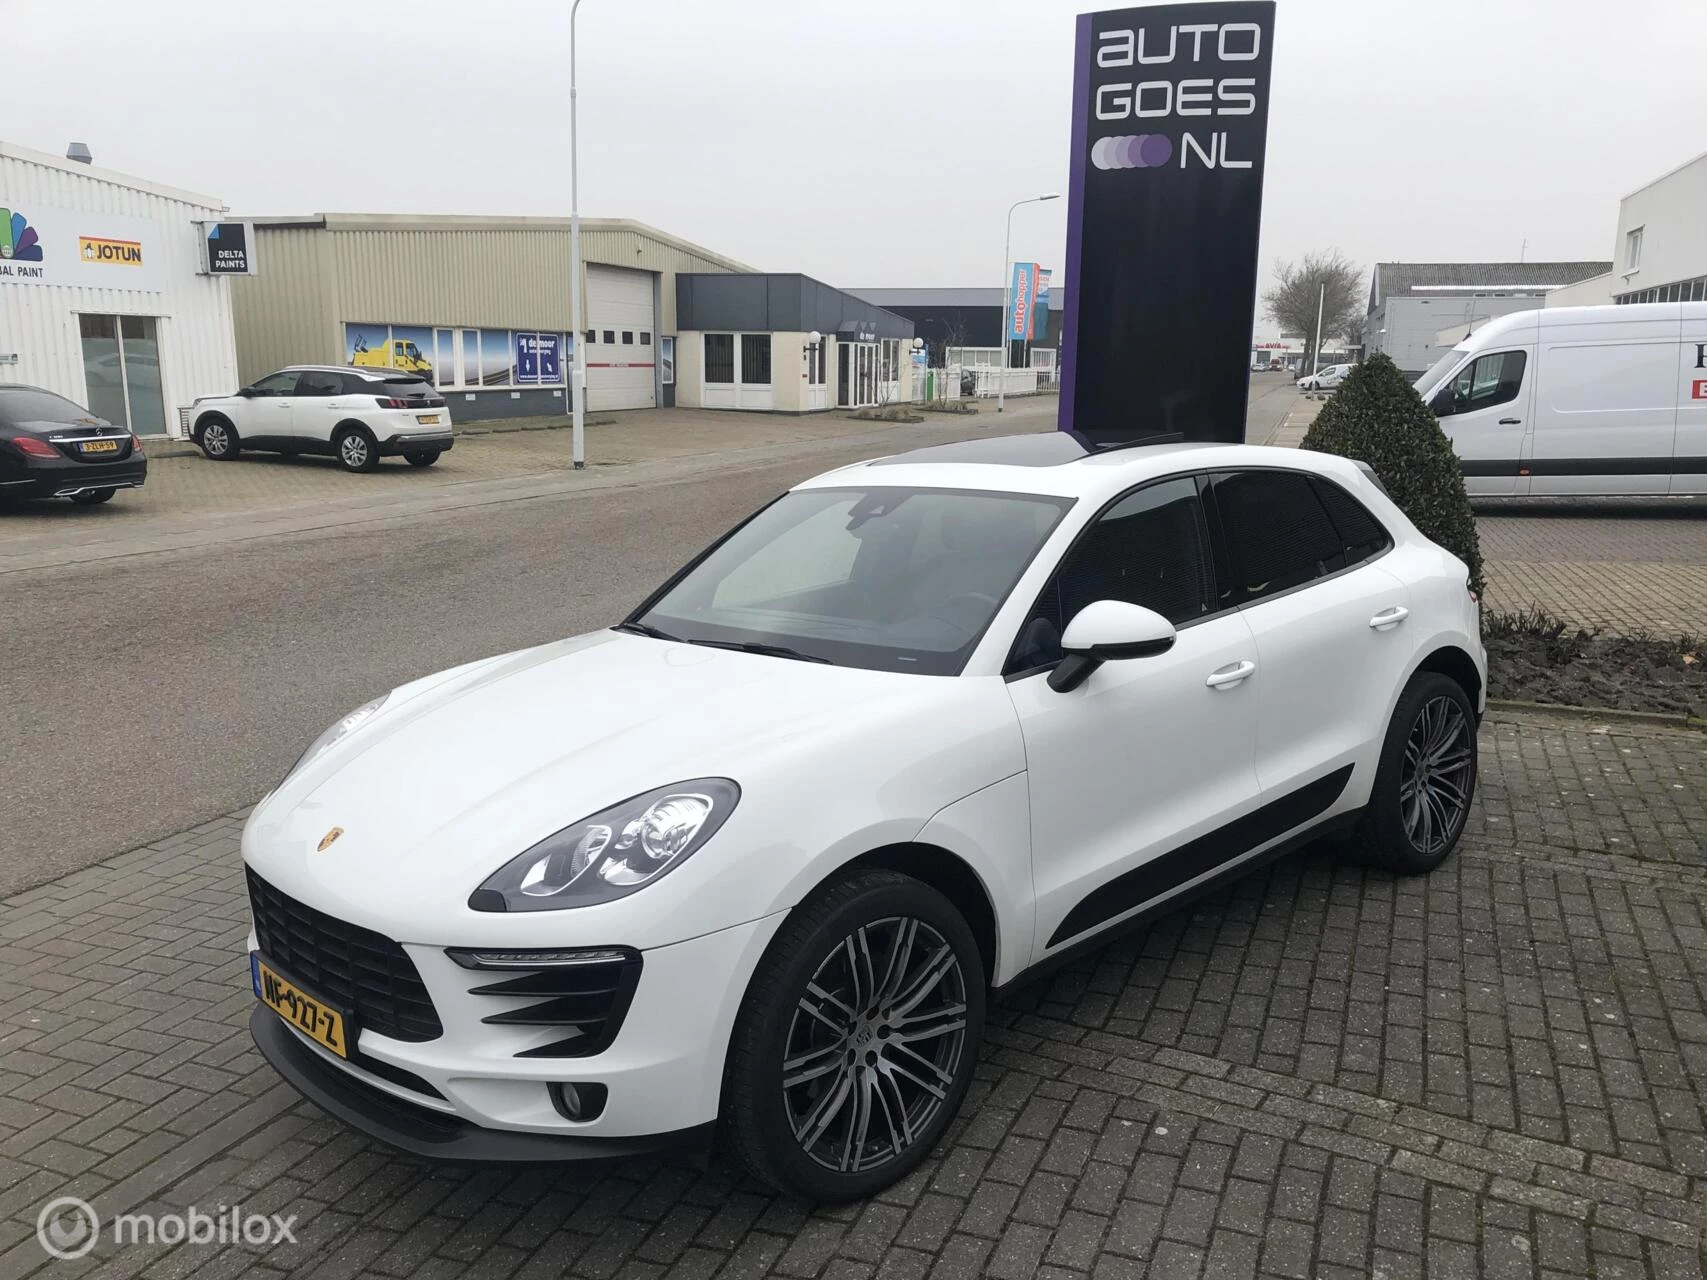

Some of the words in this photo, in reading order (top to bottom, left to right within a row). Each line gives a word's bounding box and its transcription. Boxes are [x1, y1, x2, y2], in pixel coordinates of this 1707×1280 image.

[1096, 78, 1256, 121] GOES
[1180, 132, 1253, 169] NL
[97, 245, 142, 262] JOTUN
[215, 260, 245, 268] PAINTS
[218, 250, 244, 258] DELTA
[17, 266, 43, 278] PAINT
[1014, 270, 1027, 333] autohopper
[263, 970, 338, 1047] NF-927-Z
